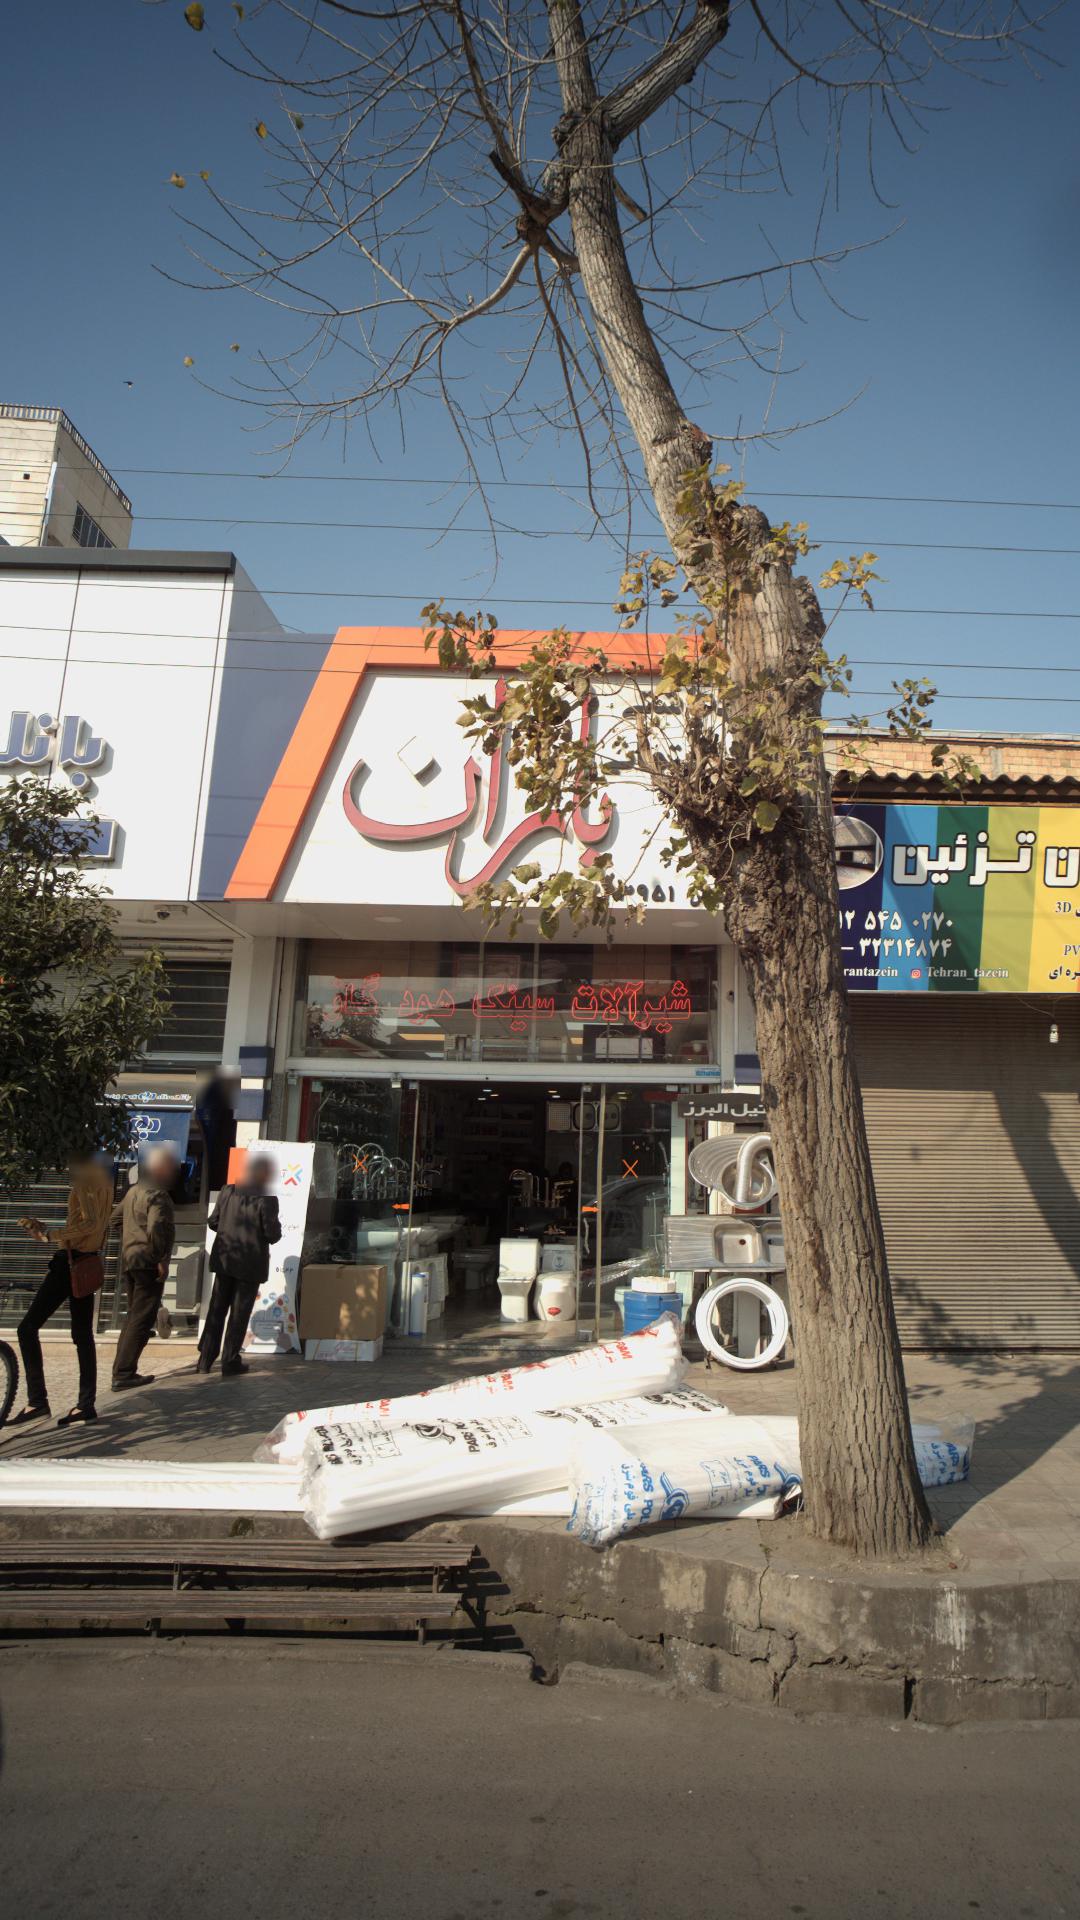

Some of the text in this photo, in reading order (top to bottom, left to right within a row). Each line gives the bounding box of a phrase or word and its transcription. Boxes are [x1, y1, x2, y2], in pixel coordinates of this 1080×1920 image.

[838, 910, 953, 931] ۱۲ ۵۴۵ ۰۲۷۰
[859, 937, 952, 957] ۳۲۳۱۴۸۷۴
[1063, 944, 1080, 956] PV
[843, 966, 1009, 981] rantazein Tehran_tazein
[398, 987, 455, 1025] هود
[472, 983, 555, 1032] سینک
[571, 980, 692, 1034] شیرآلات
[683, 1101, 729, 1117] البرز
[640, 1499, 653, 1524] POL
